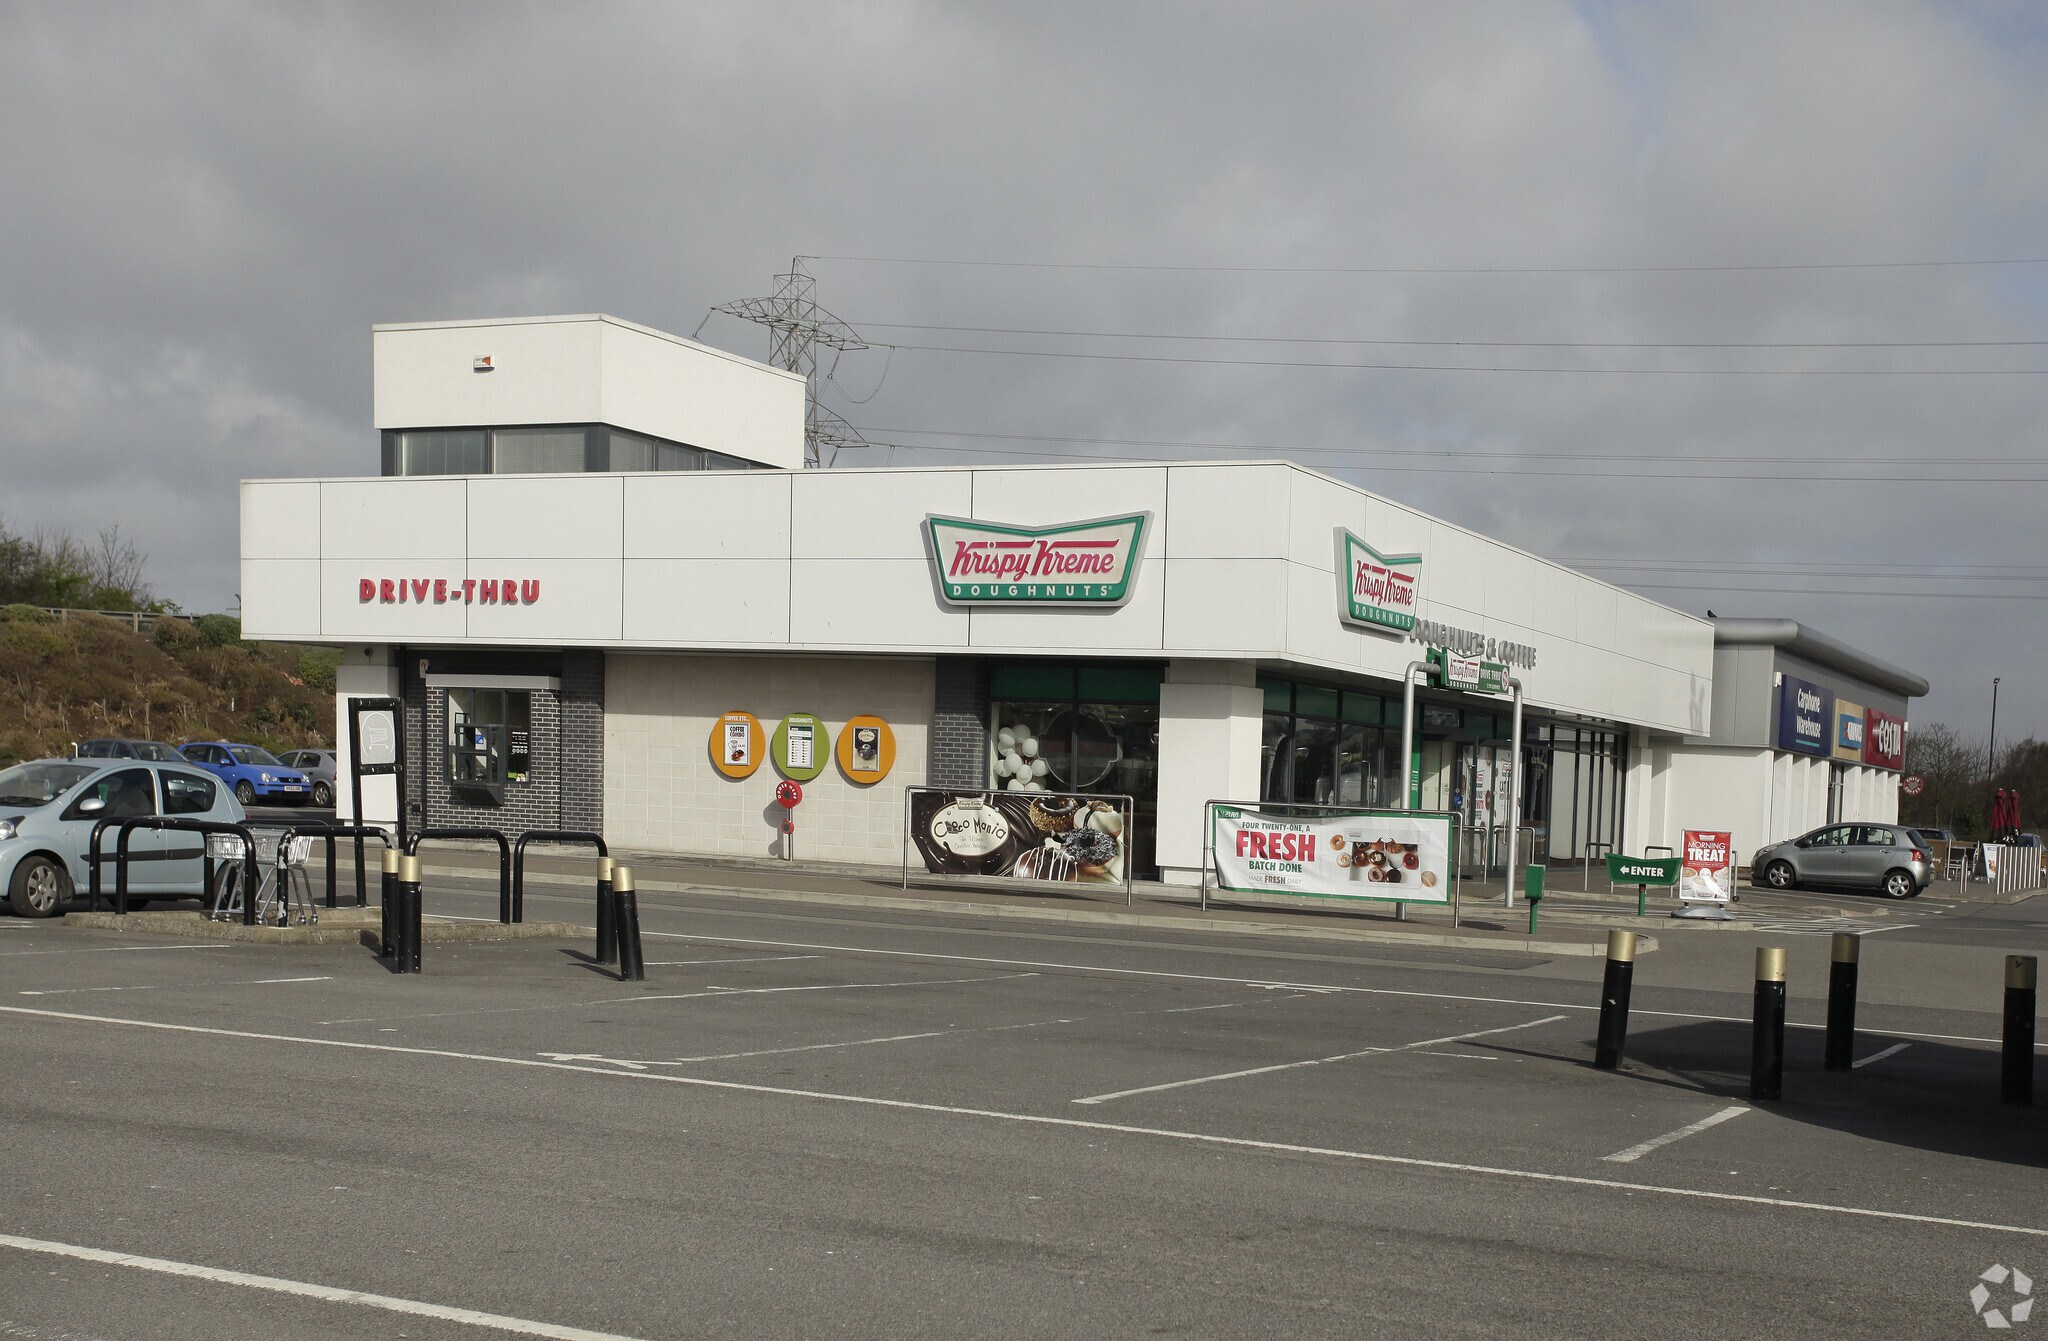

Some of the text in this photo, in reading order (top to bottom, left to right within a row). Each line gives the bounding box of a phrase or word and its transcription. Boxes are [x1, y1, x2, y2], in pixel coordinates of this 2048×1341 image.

[949, 538, 1120, 582] Krispy Kreme
[359, 578, 540, 604] DRIVE-THRU
[953, 585, 1109, 597] DOUGHNUTS
[1354, 560, 1415, 606] Krispy Kreme
[1355, 604, 1412, 628] DOUGHNUTS
[1410, 617, 1536, 670] DOUGHNUTS & COFFEE
[1797, 688, 1821, 714] Carphone
[1796, 715, 1821, 738] Warehouse
[934, 816, 1007, 840] Choco Mania
[1242, 822, 1260, 830] FOUR
[1261, 823, 1304, 833] TWENTY-ONE,
[1236, 830, 1316, 862] FRESH
[1687, 848, 1726, 862] TREAT
[1688, 841, 1726, 850] MORNING
[1249, 860, 1303, 873] BATCH DONE
[1631, 866, 1664, 877] ENTER
[1264, 875, 1286, 884] FRESH
